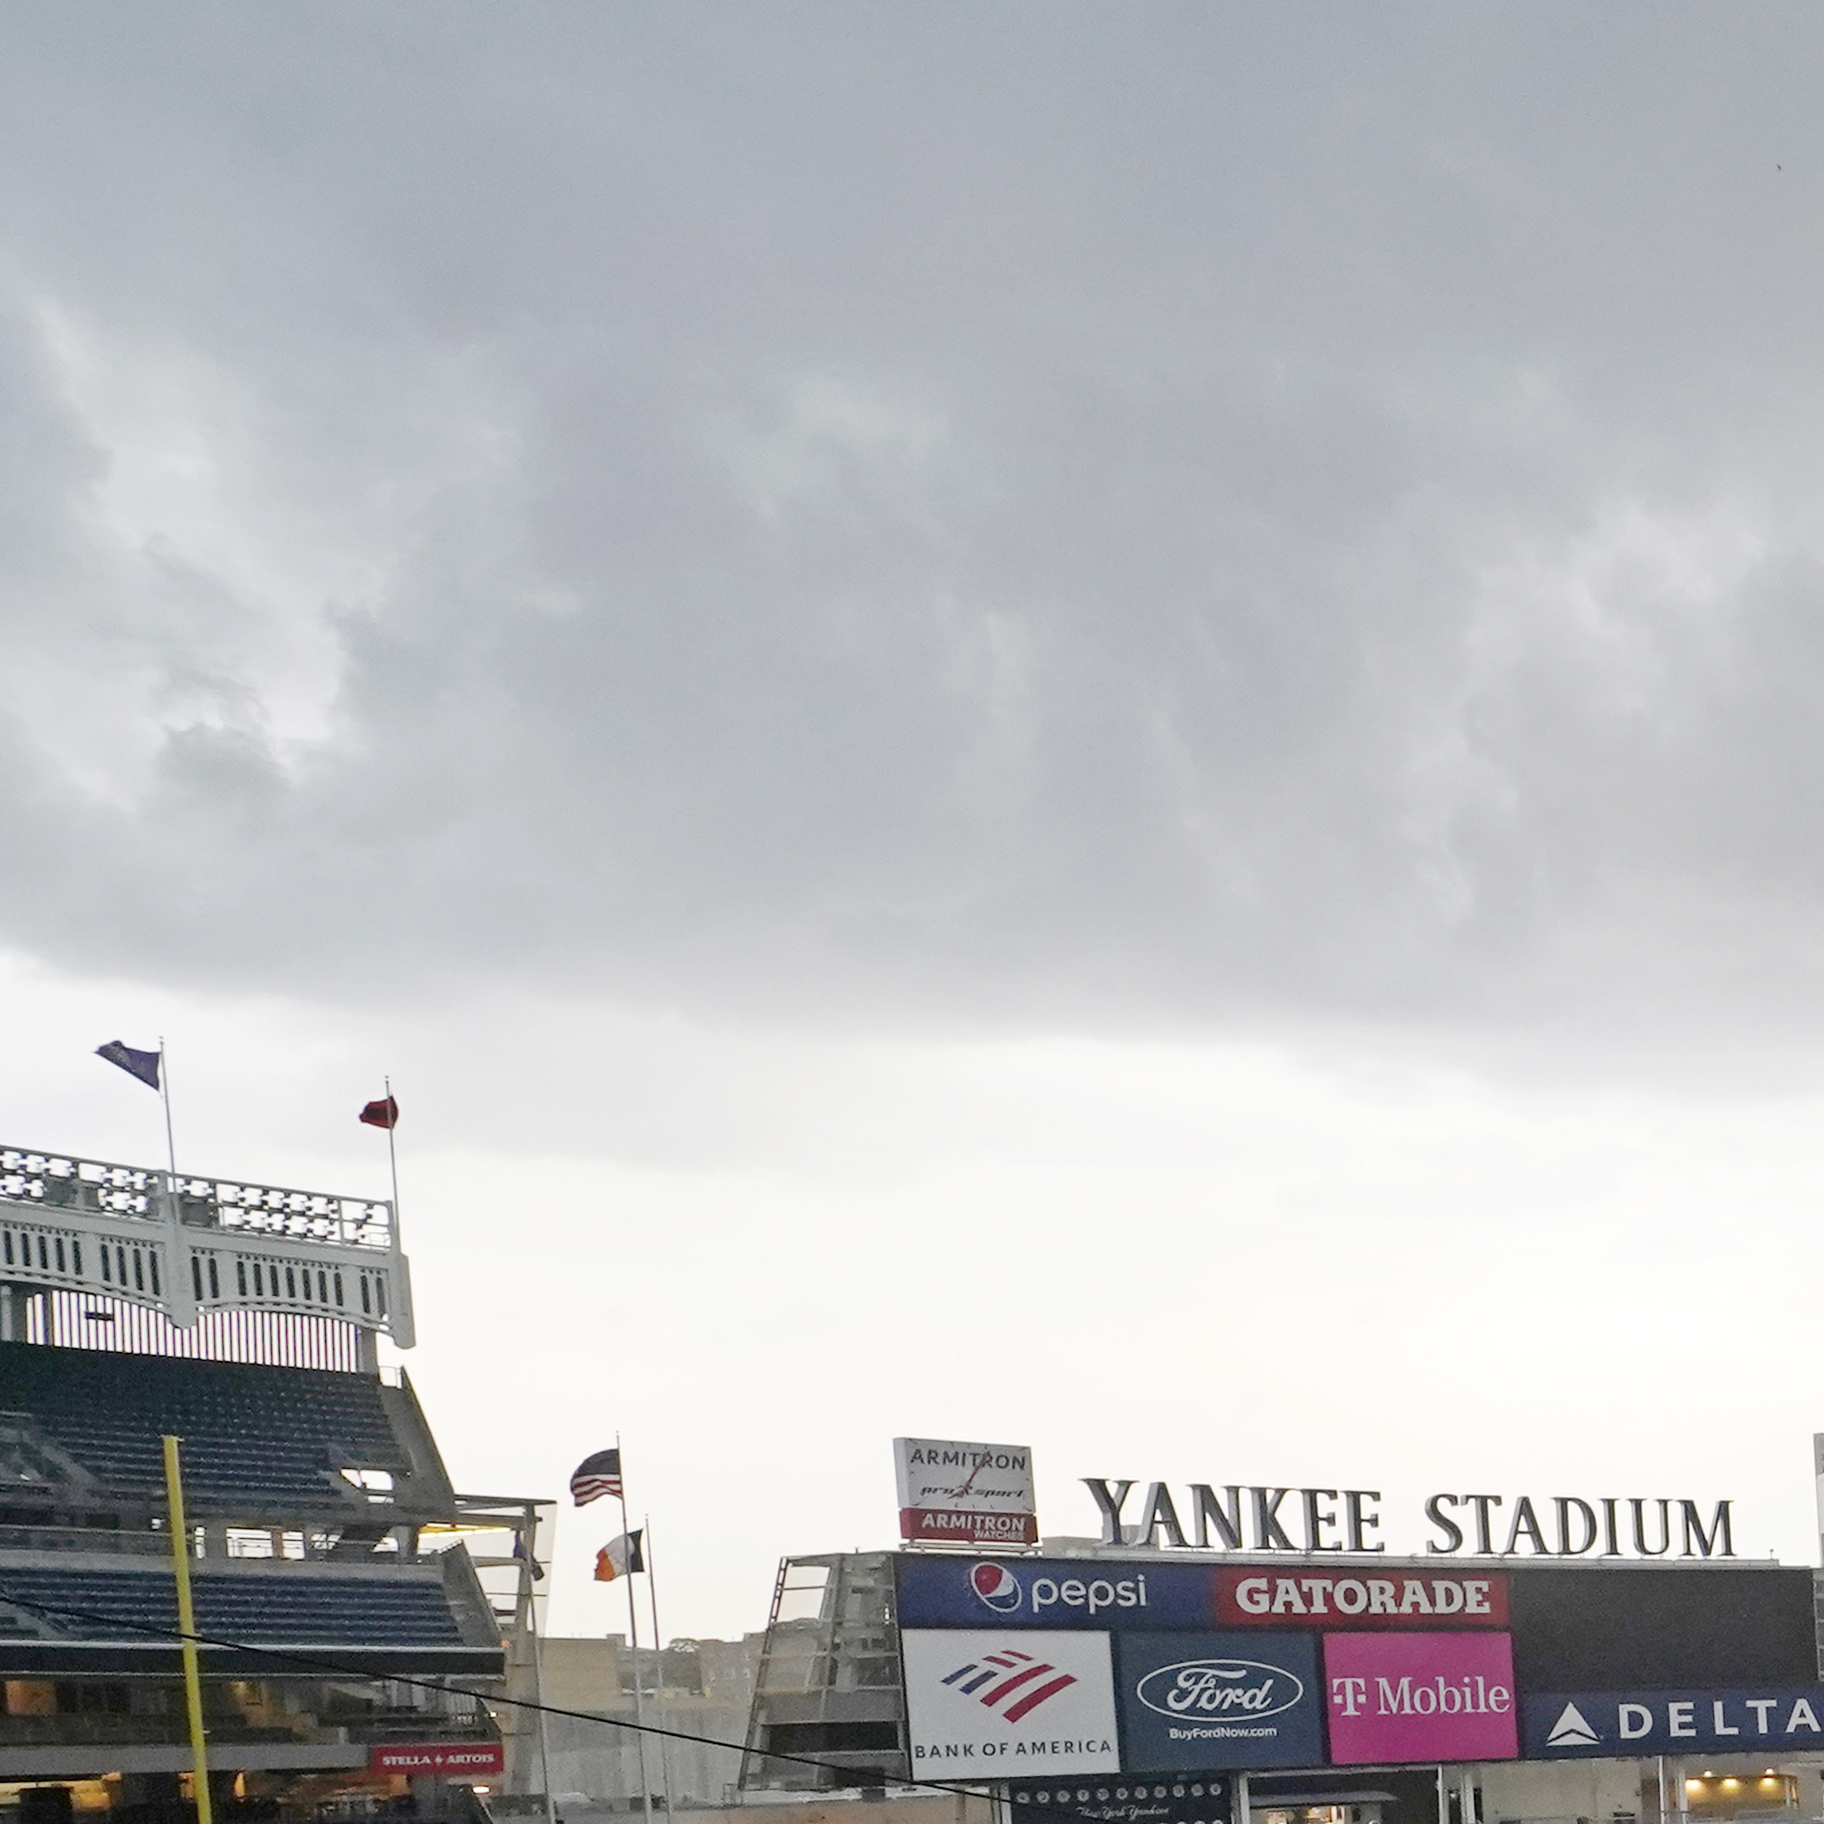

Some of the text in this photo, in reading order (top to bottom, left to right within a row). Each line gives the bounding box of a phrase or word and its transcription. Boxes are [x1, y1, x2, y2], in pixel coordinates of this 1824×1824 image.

[910, 1448, 1026, 1471] ARMITRON
[921, 1512, 1026, 1531] ARMITRON
[1079, 1477, 1737, 1557] YANKEE STADIUM
[973, 1529, 1025, 1541] WATCHES
[1031, 1573, 1148, 1614] pepsi
[1234, 1577, 1492, 1617] GATORADE
[1166, 1665, 1275, 1712] Ford
[1618, 1697, 1822, 1739] DELTA
[1168, 1726, 1278, 1741] BuyFordNow.com
[382, 1752, 496, 1767] STELLA ARTOIS
[914, 1738, 1112, 1760] BANK OF AMERICA
